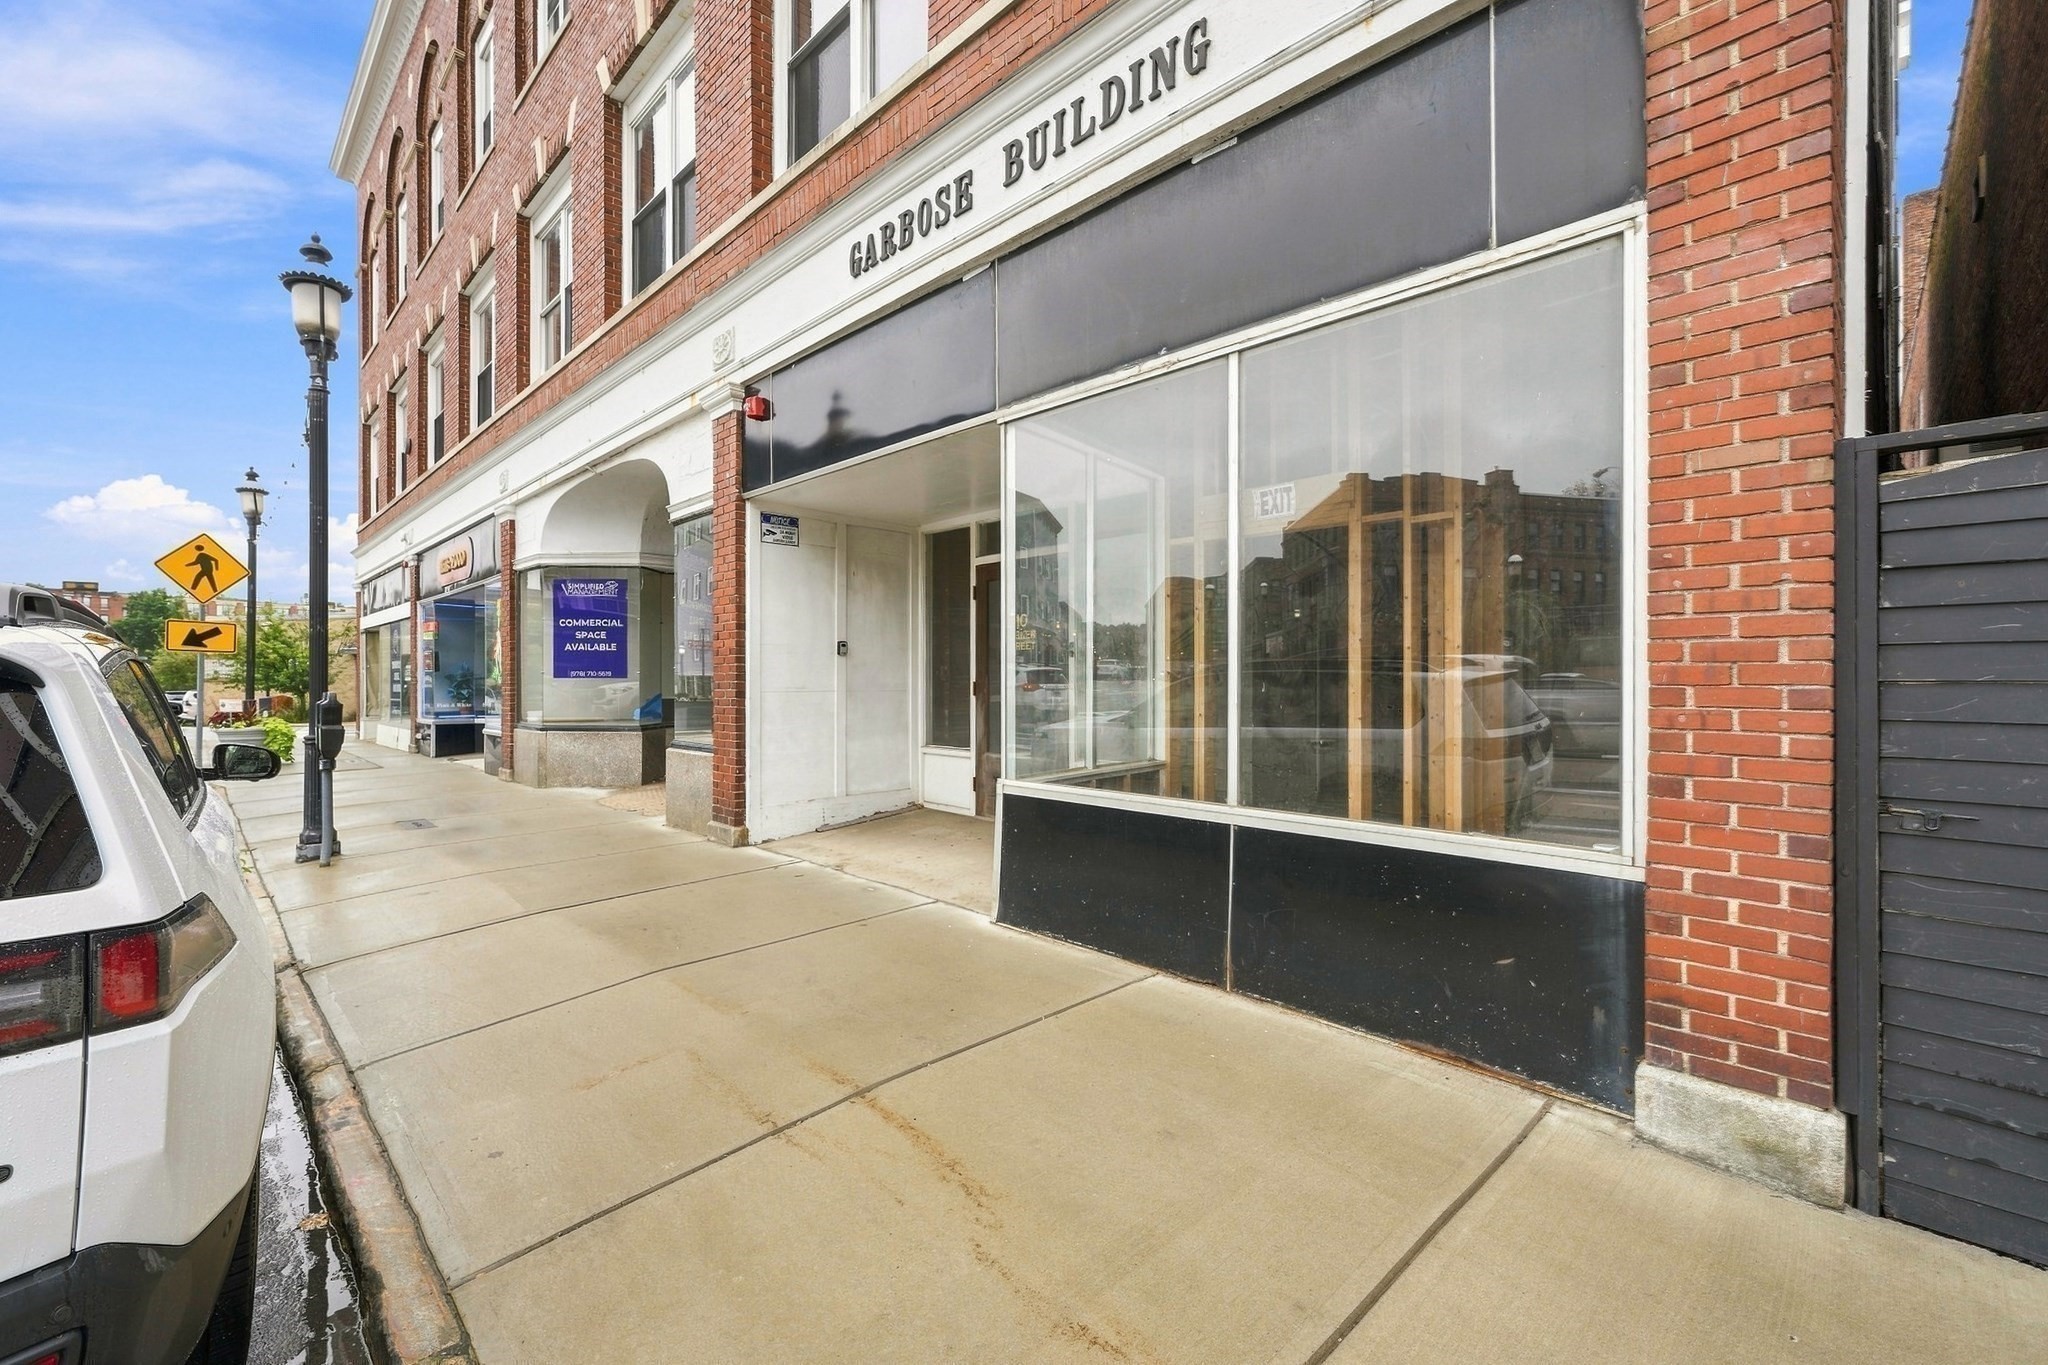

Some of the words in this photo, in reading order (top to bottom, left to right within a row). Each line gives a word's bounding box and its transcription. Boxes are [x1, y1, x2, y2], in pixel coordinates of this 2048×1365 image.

[849, 168, 974, 278] GARBOSE
[1002, 17, 1212, 188] BUILDING
[1259, 486, 1293, 516] EXIT
[559, 619, 624, 627] COMMERCIAL
[575, 631, 607, 639] SPACE
[564, 643, 617, 651] AVAILABLE
[1015, 641, 1036, 650] REET
